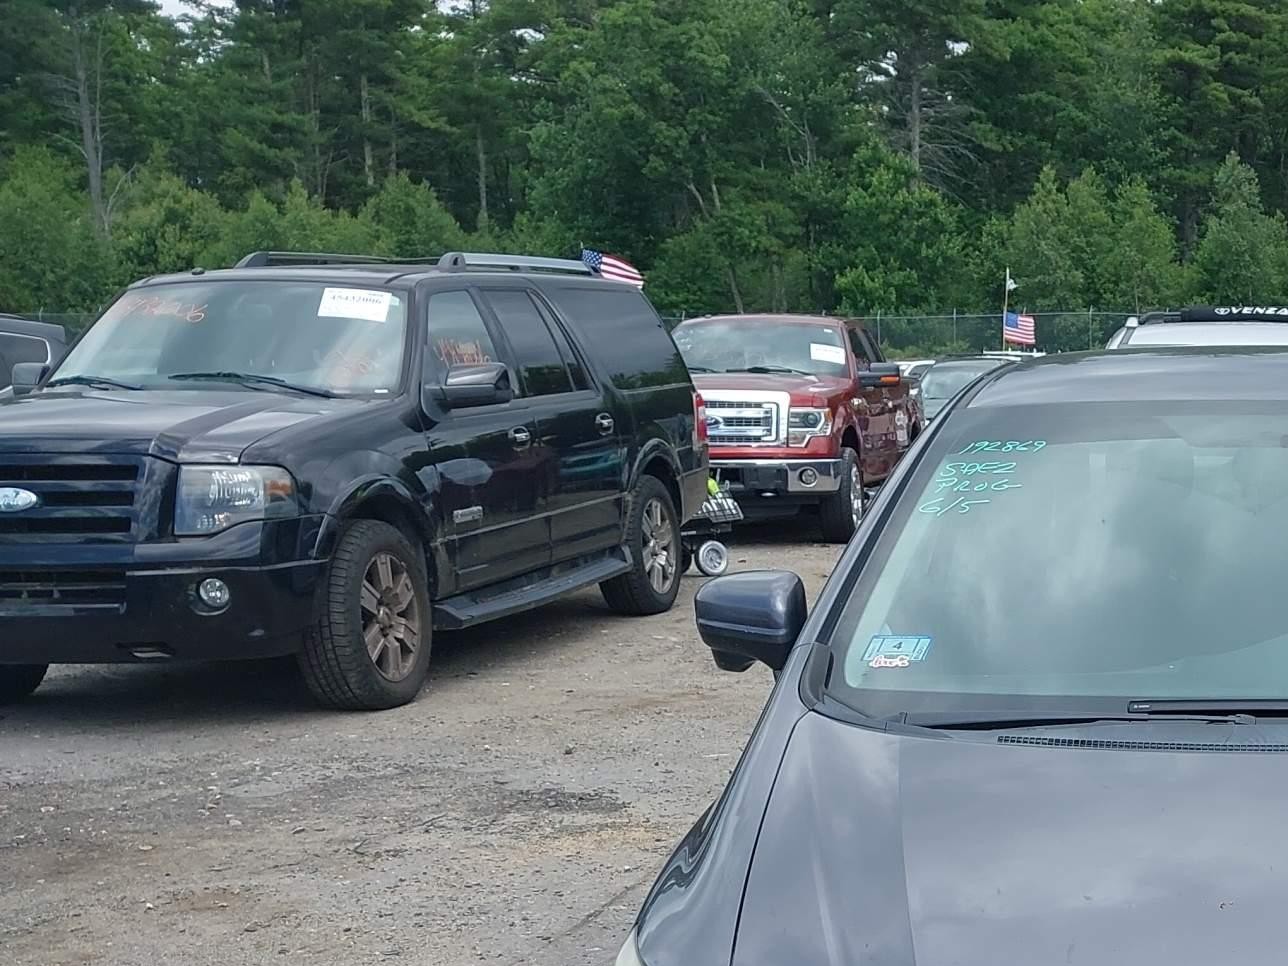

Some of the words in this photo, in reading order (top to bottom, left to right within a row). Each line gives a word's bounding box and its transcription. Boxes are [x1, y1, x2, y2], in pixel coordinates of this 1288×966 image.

[1231, 306, 1288, 315] VENZA
[959, 440, 1047, 455] 192869
[934, 477, 1023, 494] PROG
